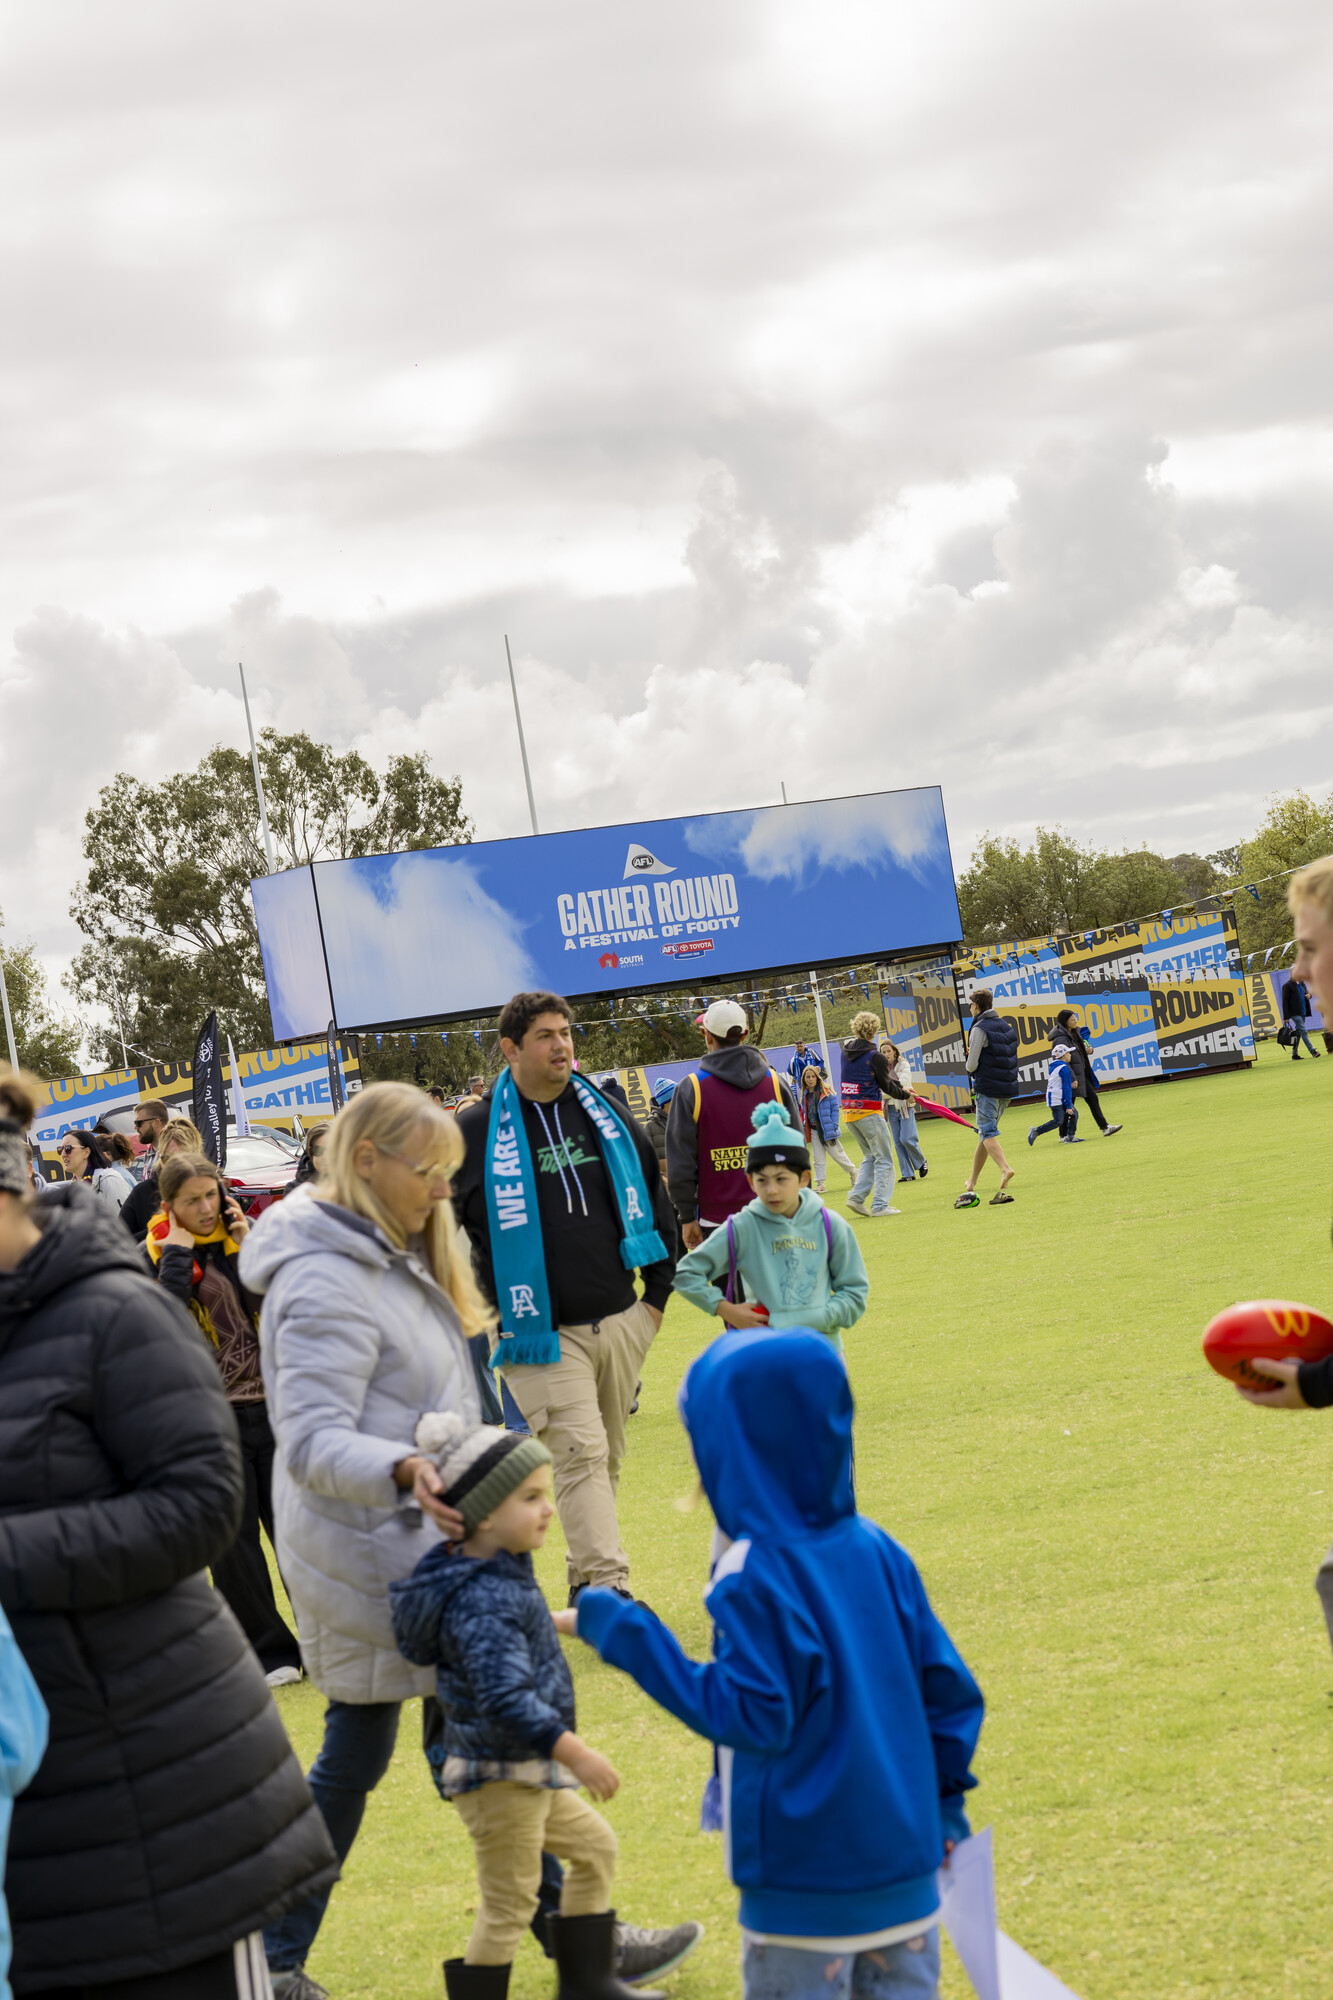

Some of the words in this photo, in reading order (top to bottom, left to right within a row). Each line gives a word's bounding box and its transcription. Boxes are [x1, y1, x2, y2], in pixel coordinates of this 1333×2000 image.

[634, 856, 652, 866] AFL
[557, 884, 653, 937] GATHER
[653, 873, 739, 924] ROUND
[564, 939, 577, 951] A
[579, 928, 659, 949] FESTIVAL
[662, 923, 683, 938] OF
[686, 916, 741, 935] FOOTY
[661, 945, 678, 954] AFL
[689, 942, 713, 950] TOYOTA
[619, 954, 644, 965] SOUTH
[1062, 953, 1149, 985] GATHER
[1145, 942, 1228, 974] GATHER
[1149, 990, 1234, 1030] ROUND
[923, 1039, 966, 1064] GATHE
[1092, 1040, 1162, 1072] ATHER
[1159, 1026, 1241, 1058] GATHER
[208, 1103, 220, 1134] Valley
[492, 1125, 522, 1177] ARE
[494, 1182, 528, 1231] WE
[509, 1284, 540, 1319] PA
